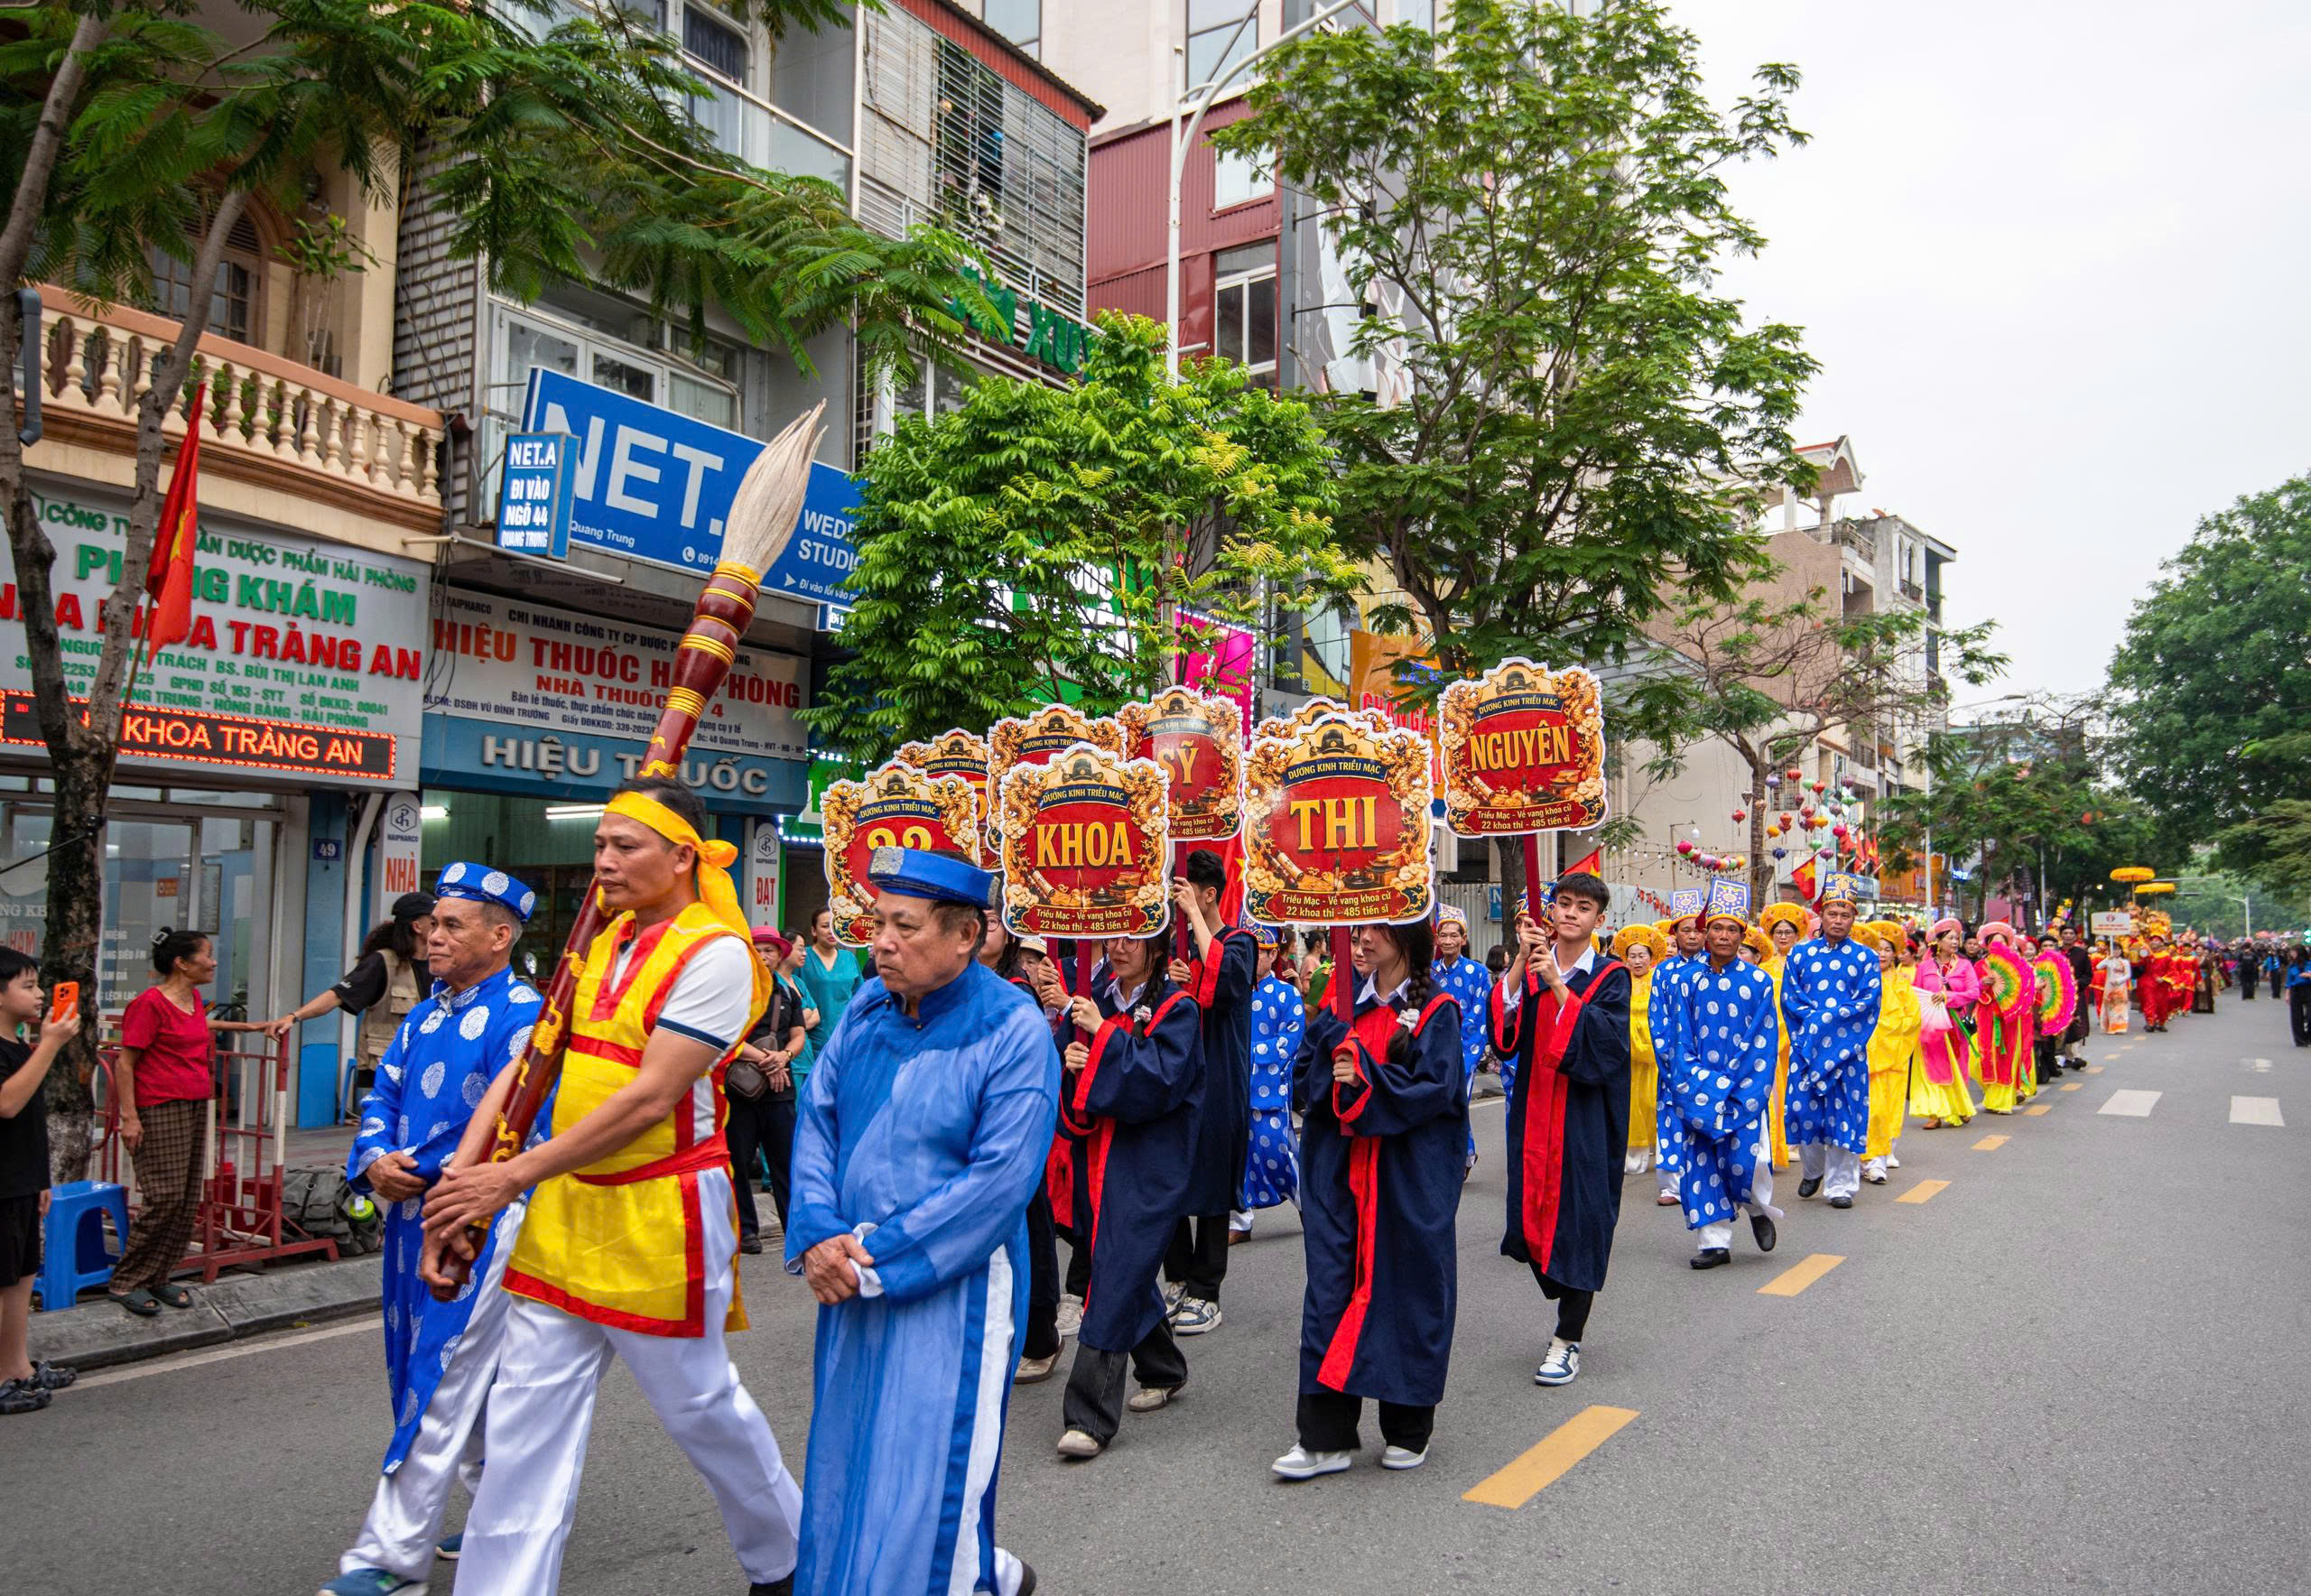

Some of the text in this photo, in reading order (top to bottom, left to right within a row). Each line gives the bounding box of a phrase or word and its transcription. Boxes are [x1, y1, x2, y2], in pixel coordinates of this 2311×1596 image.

[509, 442, 556, 466] NET.A
[510, 475, 551, 500] ĐI VÀO
[505, 502, 549, 526] NGÕ 44
[501, 530, 548, 548] QUANG TRUNG
[571, 521, 636, 548] Quang Trung
[47, 503, 418, 594] CÔNG DƯỢC PHẨM HẢI PHÒNG
[800, 579, 808, 589] Đi
[810, 582, 823, 593] vào
[237, 578, 357, 626] KHÁM
[508, 609, 529, 625] CHI
[574, 621, 605, 638] CÔNG
[608, 628, 620, 642] TY
[623, 634, 637, 646] CP
[228, 620, 422, 680] TRÀNG AN
[156, 651, 360, 692] TRÁCH BS. BÙI THỊ LAN ANH
[433, 617, 517, 664] HIỆU
[529, 636, 640, 684] THUỐC
[722, 673, 801, 709] HÒNG
[209, 679, 227, 699] SỐ
[231, 684, 251, 698] 163
[262, 688, 285, 702] SYT
[300, 691, 317, 708] SỐ
[511, 691, 530, 704] Bán
[542, 693, 569, 711] thuốc,
[591, 703, 614, 718] phẩm
[536, 674, 585, 697] NHÀ
[593, 684, 667, 710] THUỐC
[156, 691, 204, 707] TRUNG
[302, 707, 324, 723] HẢI
[326, 710, 368, 728] PHÒNG
[1479, 701, 1502, 715] DƯƠNG
[1503, 698, 1520, 708] KINH
[1542, 698, 1558, 708] MẠC
[124, 714, 364, 766] KHOA TRÀNG AN
[562, 713, 580, 726] Giấy
[719, 736, 740, 747] Quang
[742, 739, 759, 749] Trung
[1044, 738, 1059, 747] KINH
[483, 736, 599, 780] HIỆU
[1470, 719, 1571, 773] NGUYÊN
[944, 759, 958, 768] KINH
[1287, 766, 1315, 780] DƯƠNG
[1317, 762, 1337, 773] KINH
[1363, 762, 1381, 776] MẠC
[1043, 791, 1067, 803] DƯƠNG
[1069, 789, 1085, 799] KINH
[1108, 791, 1124, 803] MẠC
[859, 805, 883, 819] DƯƠNG
[884, 803, 900, 812] KINH
[921, 804, 936, 816] MẠC
[1290, 795, 1378, 851] THI
[1495, 811, 1510, 821] Mạc
[1527, 810, 1544, 820] vang
[1545, 805, 1562, 815] khoa
[1182, 828, 1193, 836] 485
[1481, 821, 1491, 830] 22
[1493, 821, 1511, 830] khoa
[1513, 821, 1523, 830] thi
[1530, 819, 1545, 828] 485
[319, 843, 337, 857] 49
[1035, 821, 1134, 868] KHOA
[385, 852, 417, 893] NHÀ
[1285, 906, 1297, 916] 22
[1299, 906, 1321, 917] khoa
[1323, 907, 1335, 917] thi
[1343, 906, 1360, 916] 485
[1304, 896, 1321, 907] Mạc
[1340, 897, 1359, 909] vang
[1360, 894, 1380, 904] khoa
[1039, 920, 1049, 929] 22
[1051, 921, 1070, 931] khoa
[1072, 921, 1082, 931] thi
[1091, 921, 1105, 931] 485
[1055, 911, 1070, 923] Mạc
[1087, 912, 1103, 923] vang
[1104, 910, 1121, 919] khoa
